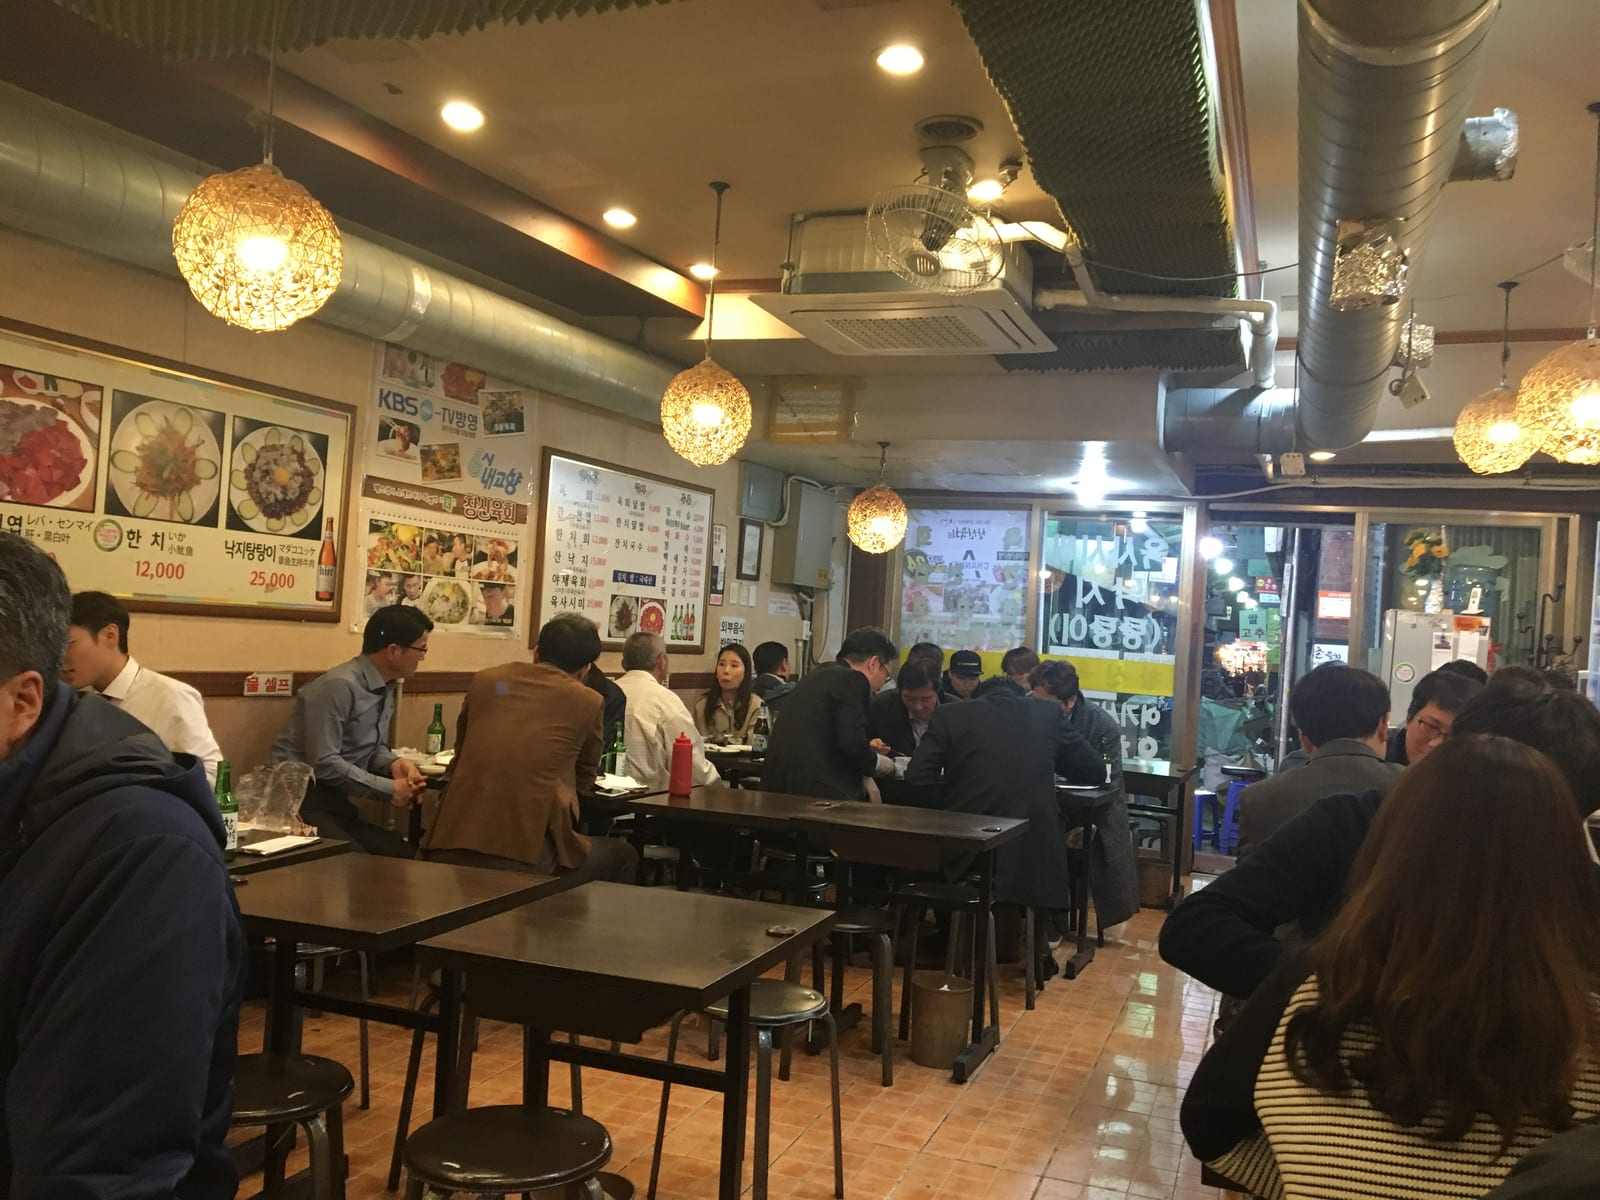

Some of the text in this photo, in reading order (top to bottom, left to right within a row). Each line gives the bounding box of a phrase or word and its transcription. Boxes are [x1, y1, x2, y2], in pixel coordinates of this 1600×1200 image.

[379, 388, 418, 416] KBS
[480, 466, 524, 495] 내고향
[463, 493, 517, 524] 창신육회
[168, 531, 186, 541] いか
[224, 540, 276, 563] 낙지탕탕이
[135, 560, 185, 580] 12,000
[250, 571, 295, 589] 25,000
[720, 620, 745, 636] 외부음식
[1248, 613, 1258, 624] 쌀
